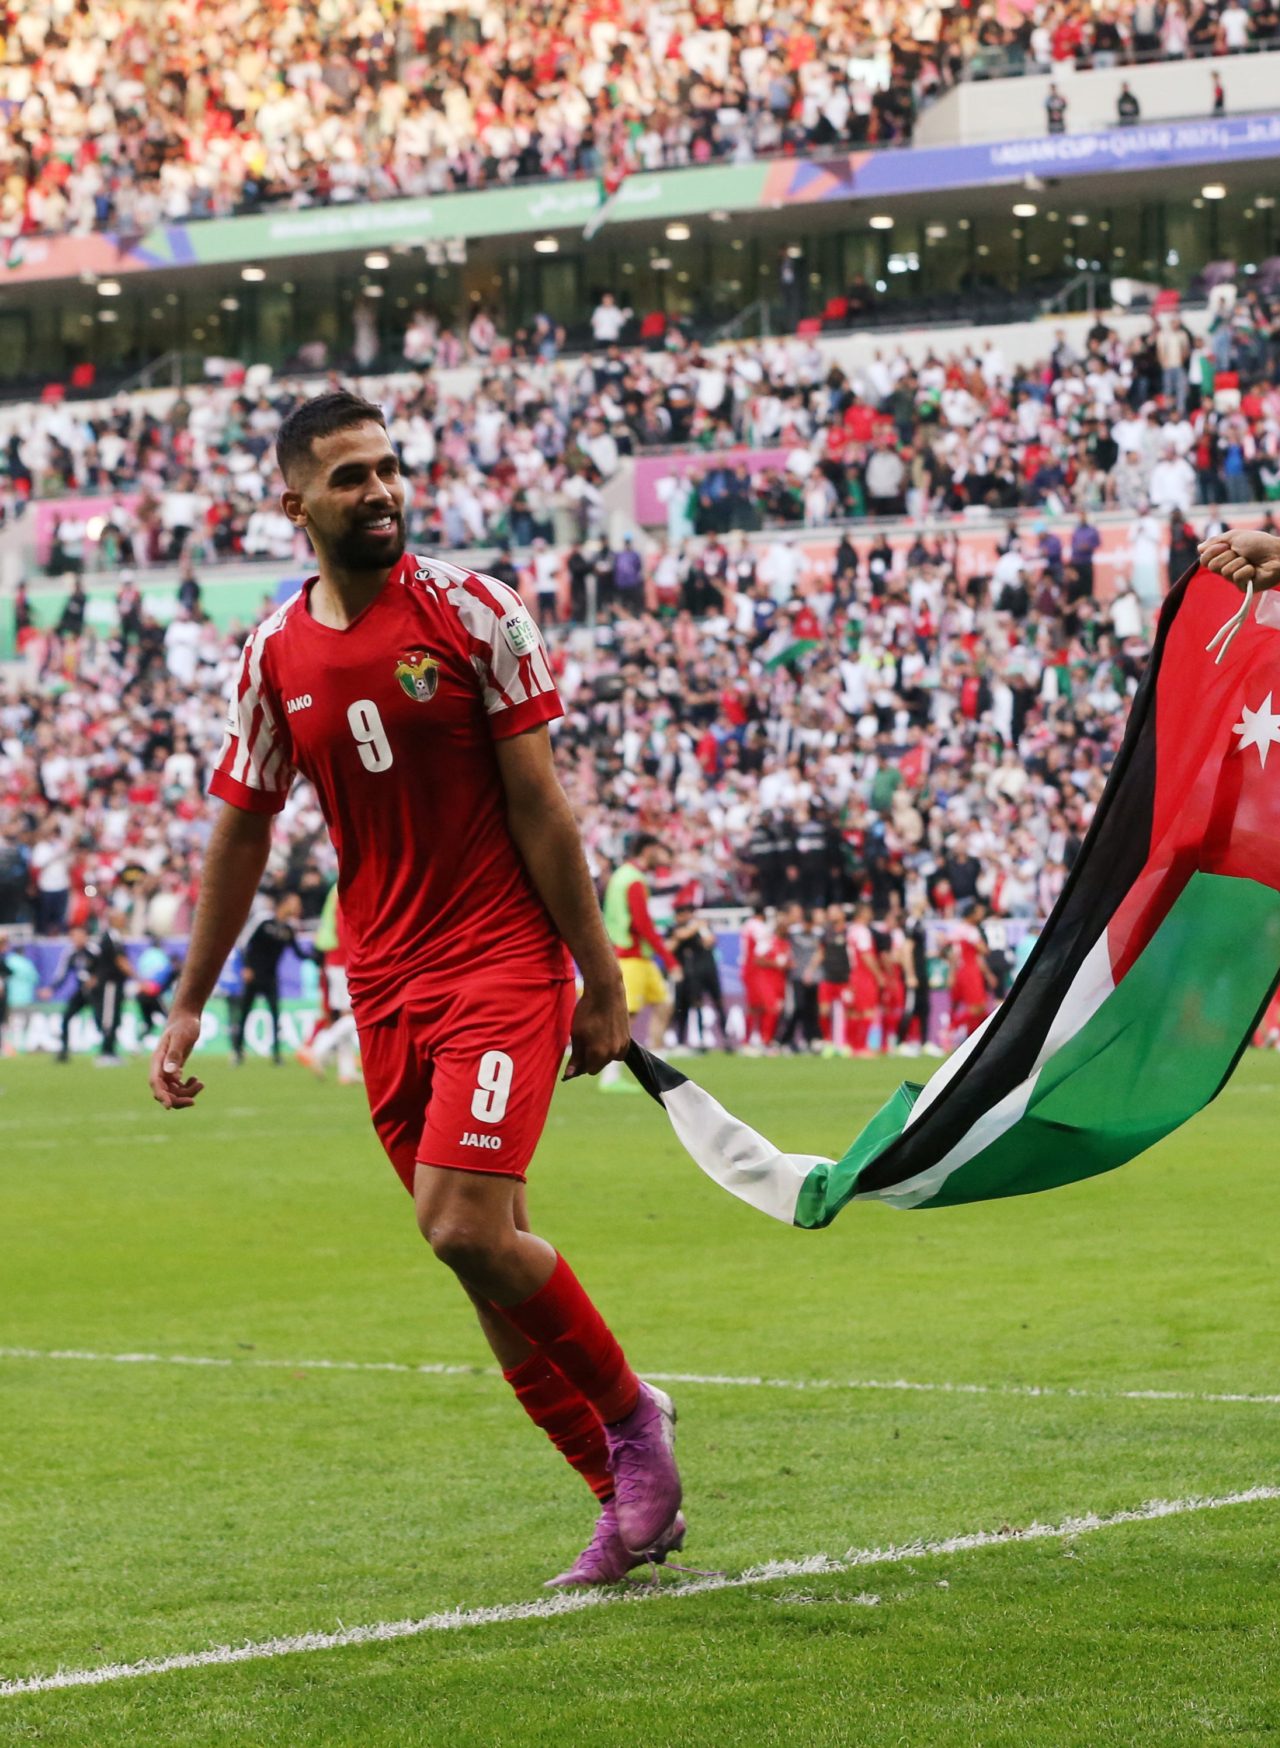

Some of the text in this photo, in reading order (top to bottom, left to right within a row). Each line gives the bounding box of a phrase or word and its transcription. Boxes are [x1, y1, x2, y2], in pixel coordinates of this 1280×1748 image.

[506, 616, 521, 629] AFC
[508, 620, 531, 641] LIVE
[286, 693, 313, 714] JAKO
[347, 699, 393, 773] 9
[471, 1050, 514, 1124] 9
[459, 1132, 502, 1150] JAKO
